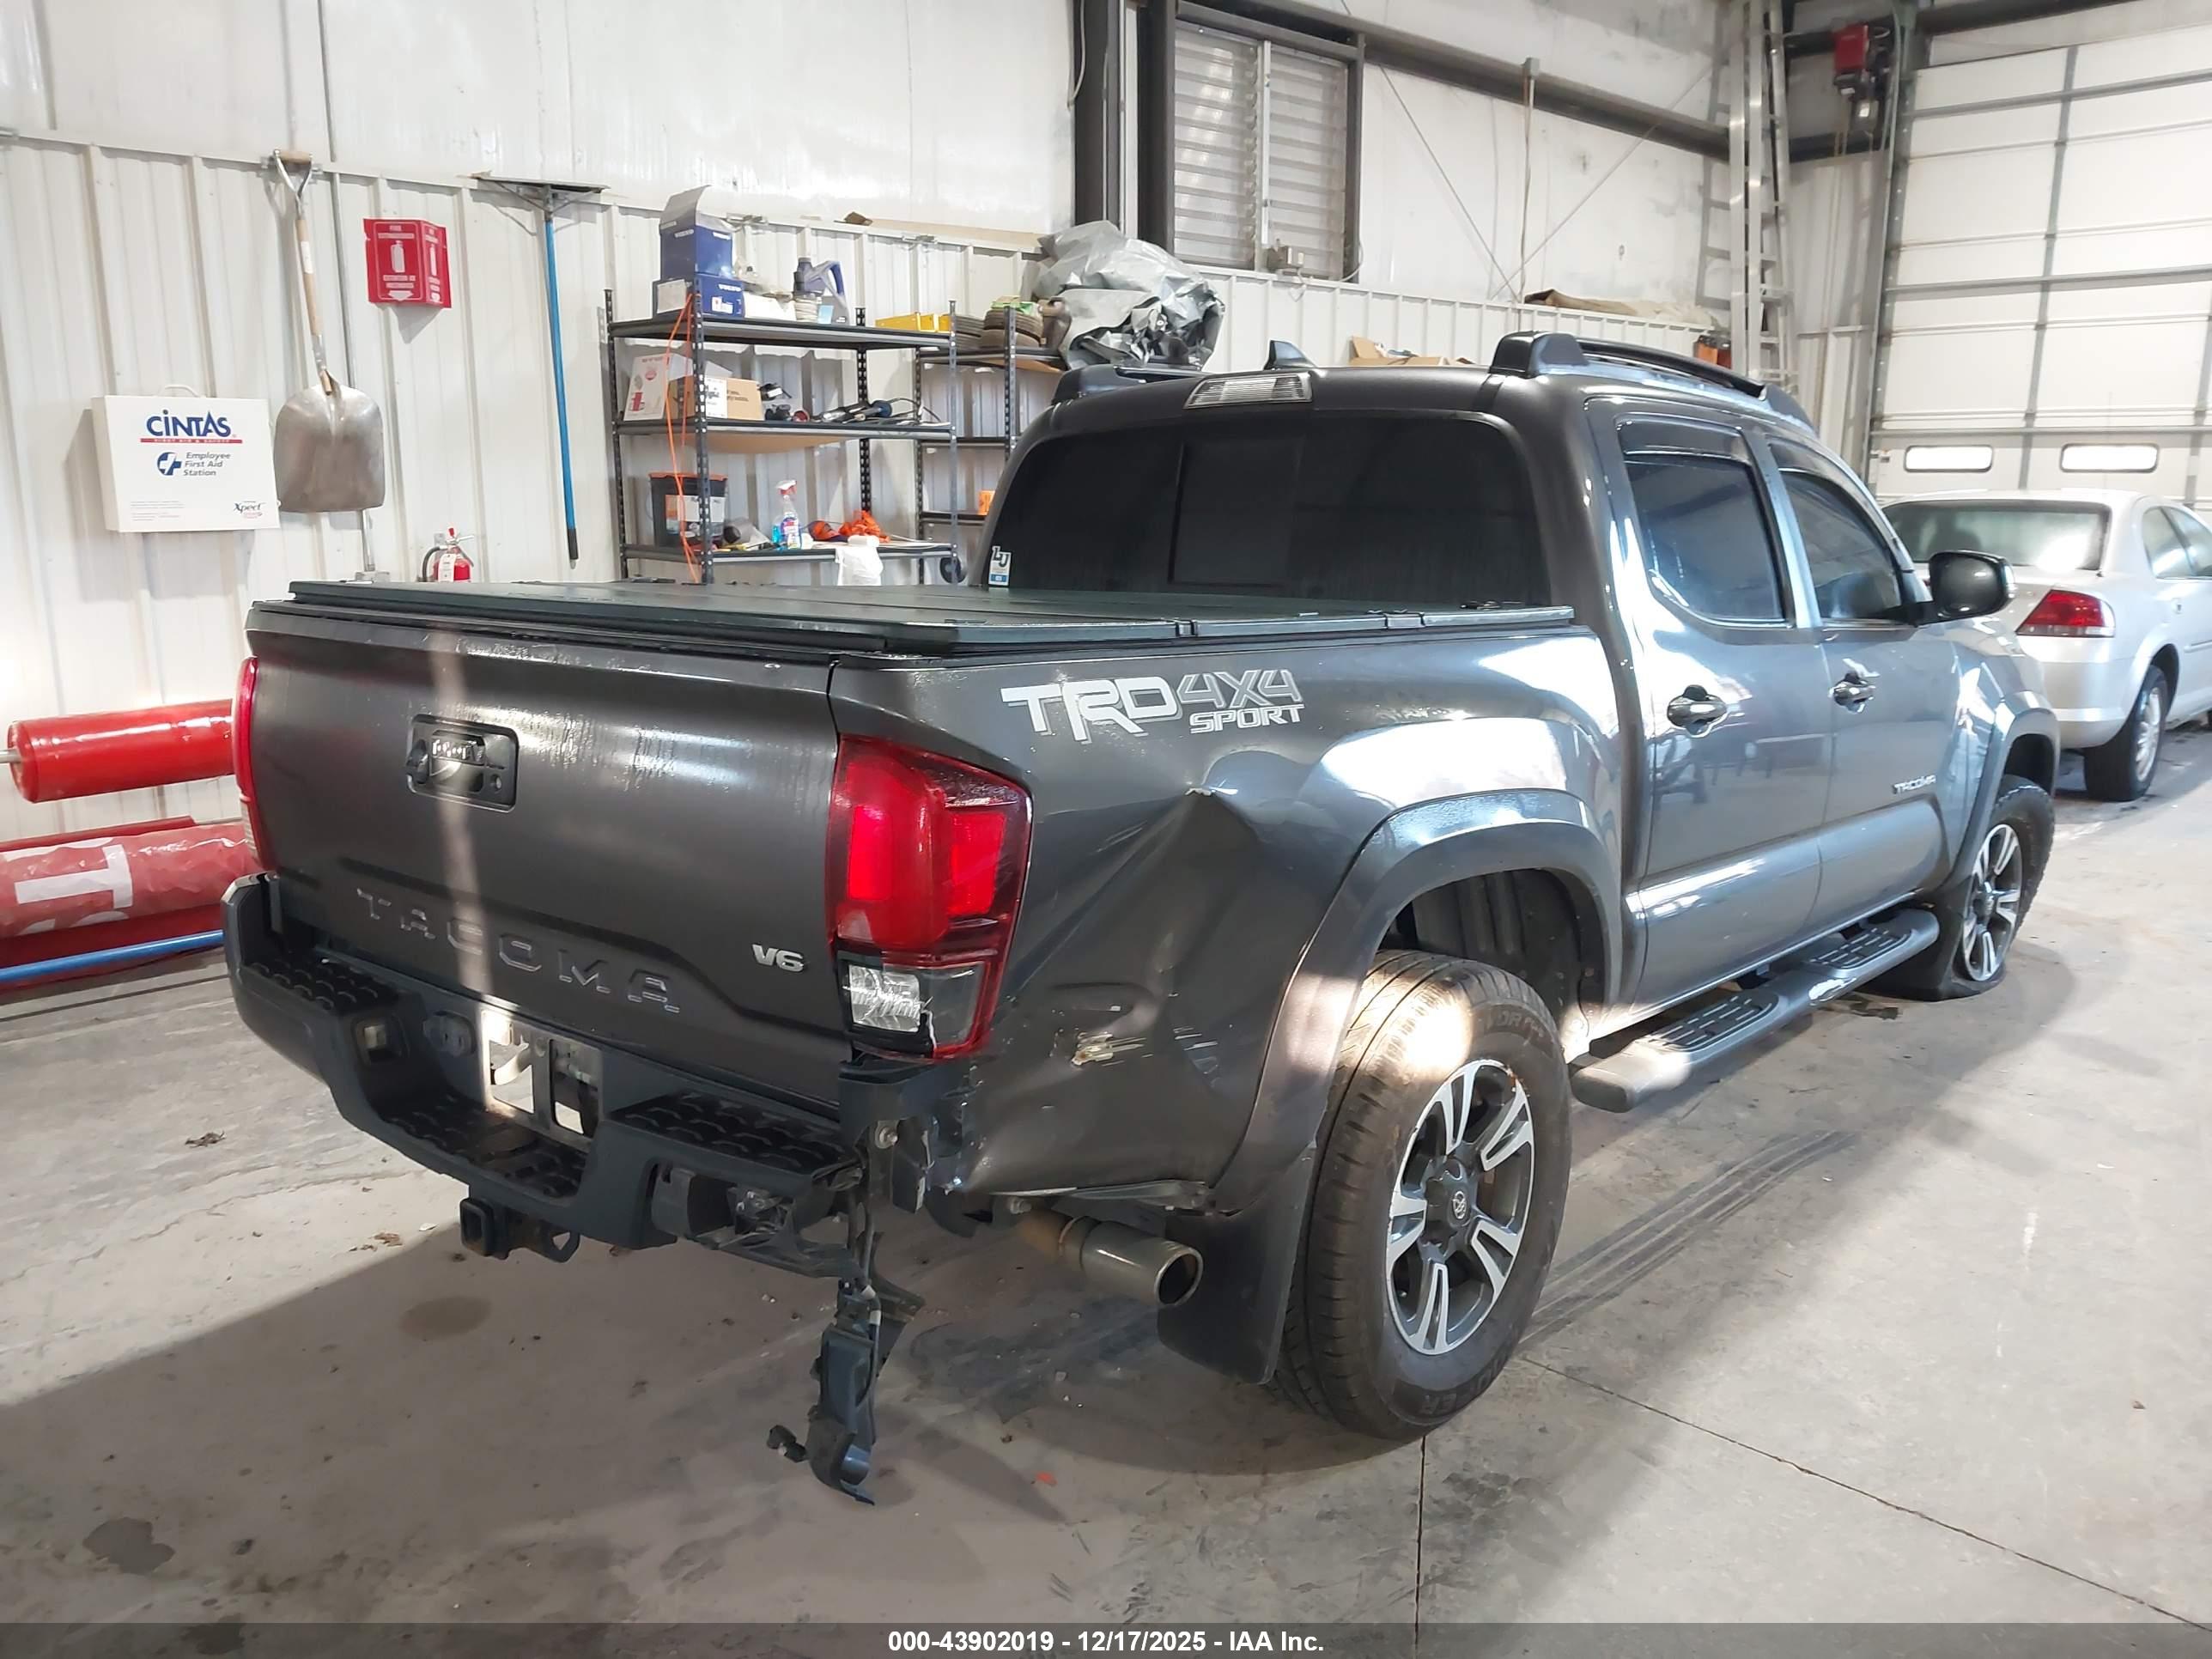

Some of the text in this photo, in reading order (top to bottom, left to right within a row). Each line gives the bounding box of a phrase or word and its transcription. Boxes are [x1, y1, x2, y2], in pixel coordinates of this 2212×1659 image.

[185, 452, 231, 460] Employee
[1000, 669, 1304, 744] TRD 4X4
[1189, 704, 1305, 734] SPORT
[1893, 775, 1936, 794] TACOMA
[356, 887, 681, 1013] TACOMA
[752, 944, 805, 973] V6
